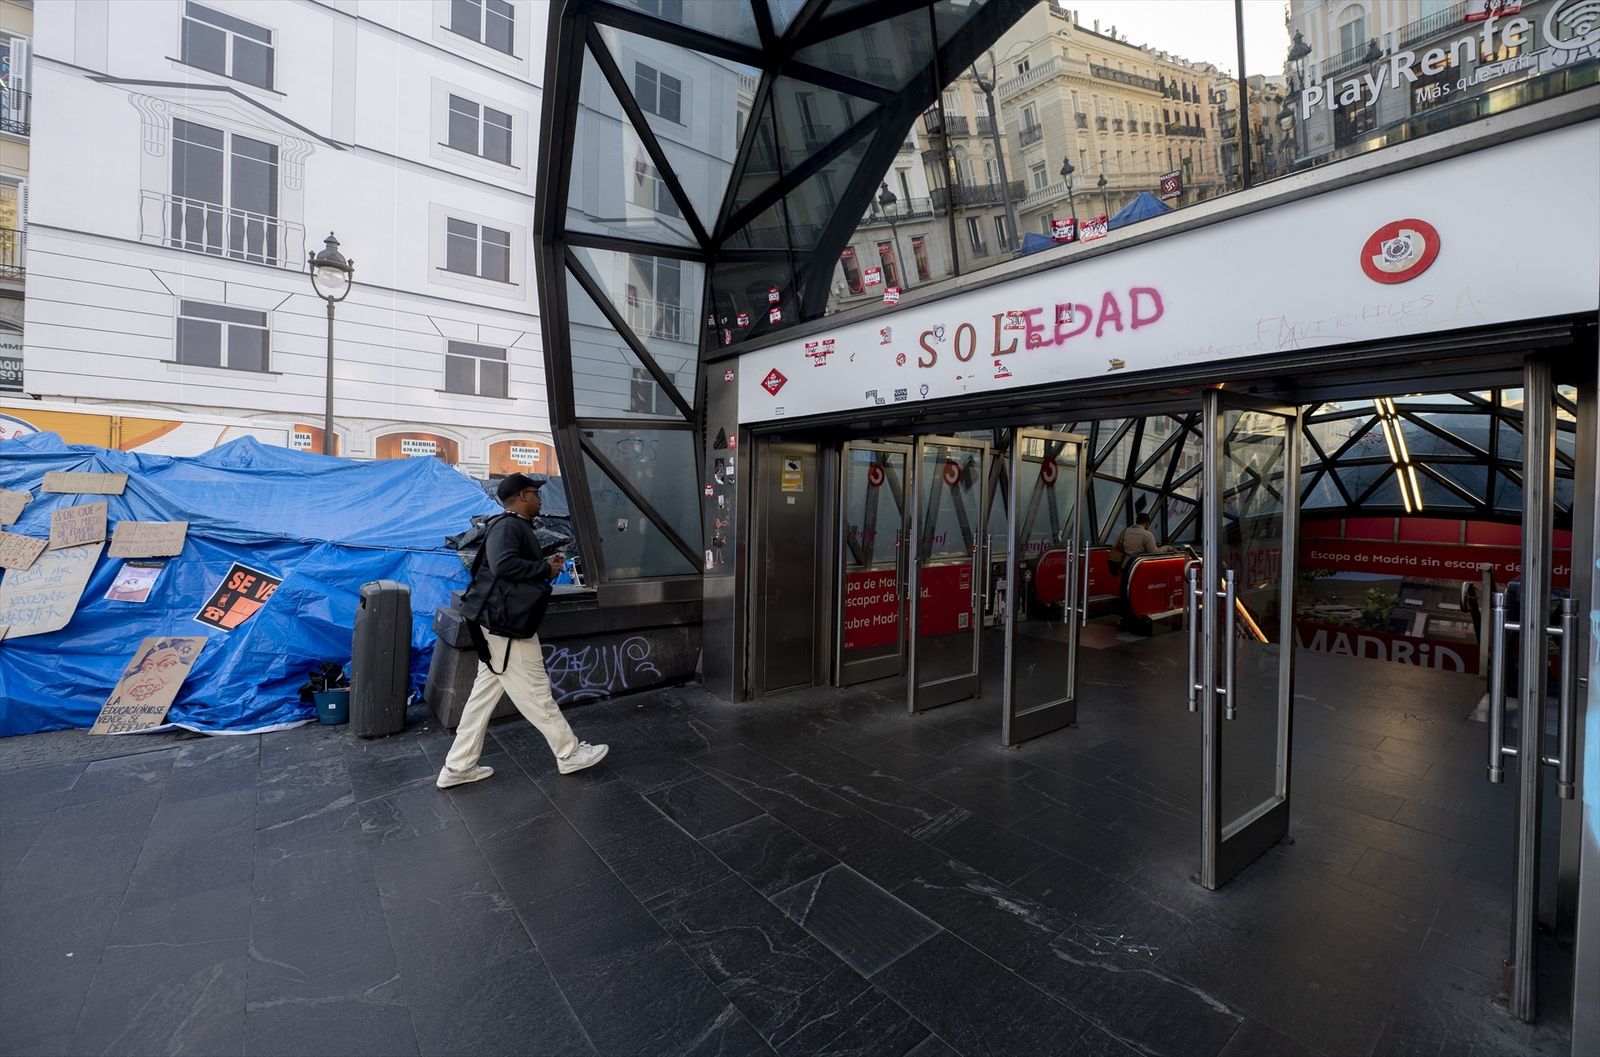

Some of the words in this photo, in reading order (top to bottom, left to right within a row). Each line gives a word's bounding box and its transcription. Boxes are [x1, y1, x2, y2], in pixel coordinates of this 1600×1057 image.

[1302, 16, 1529, 120] PlayRenfe
[1416, 82, 1450, 104] Más
[1456, 69, 1493, 92] que
[1311, 550, 1351, 562] Escapa
[1353, 552, 1369, 563] de
[1372, 553, 1418, 566] Madrid
[1420, 557, 1441, 567] sin
[1444, 559, 1500, 571] escapr
[227, 571, 257, 594] SE
[863, 578, 876, 590] de
[882, 591, 895, 604] de
[106, 695, 121, 706] LA
